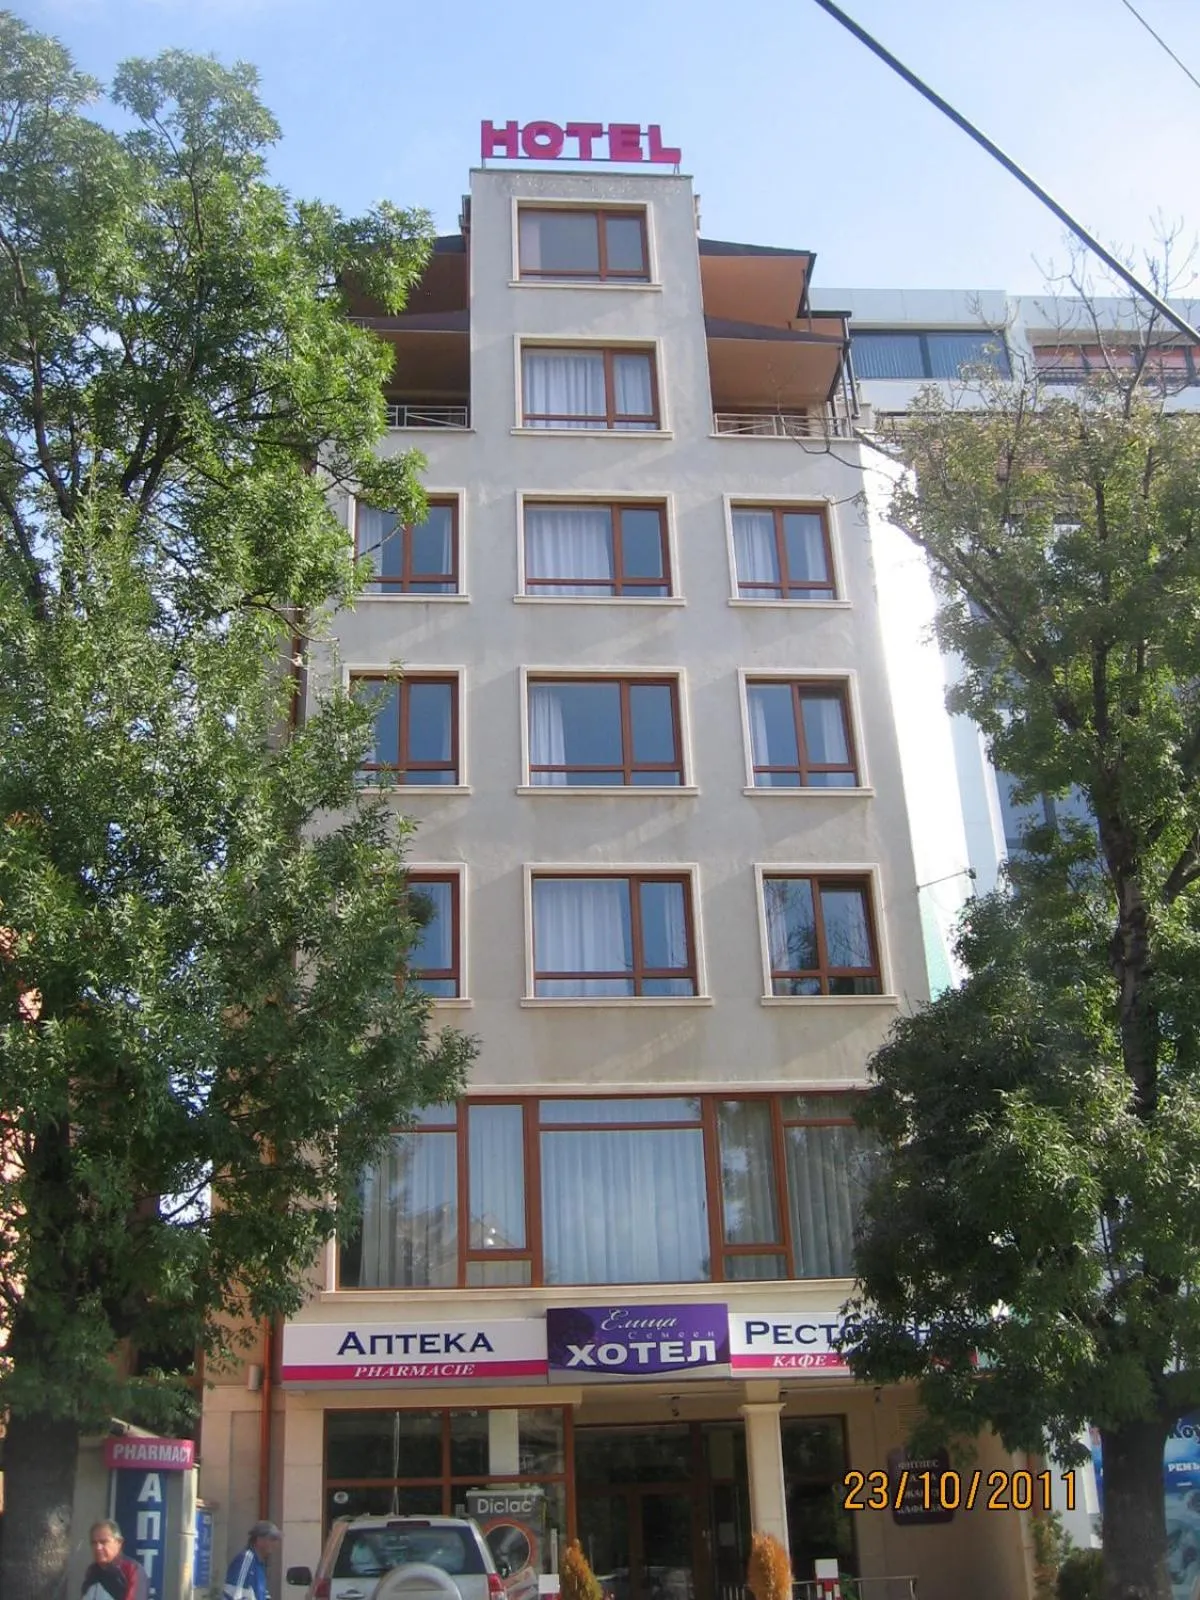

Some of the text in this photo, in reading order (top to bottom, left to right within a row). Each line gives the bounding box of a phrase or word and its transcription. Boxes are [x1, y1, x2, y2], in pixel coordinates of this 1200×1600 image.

[481, 120, 681, 164] HOTEL
[566, 1340, 717, 1366] ХОТЕЛ
[773, 1355, 828, 1368] КАФЕ
[354, 1363, 476, 1377] PHARMACIE
[477, 1498, 532, 1513] Diclac
